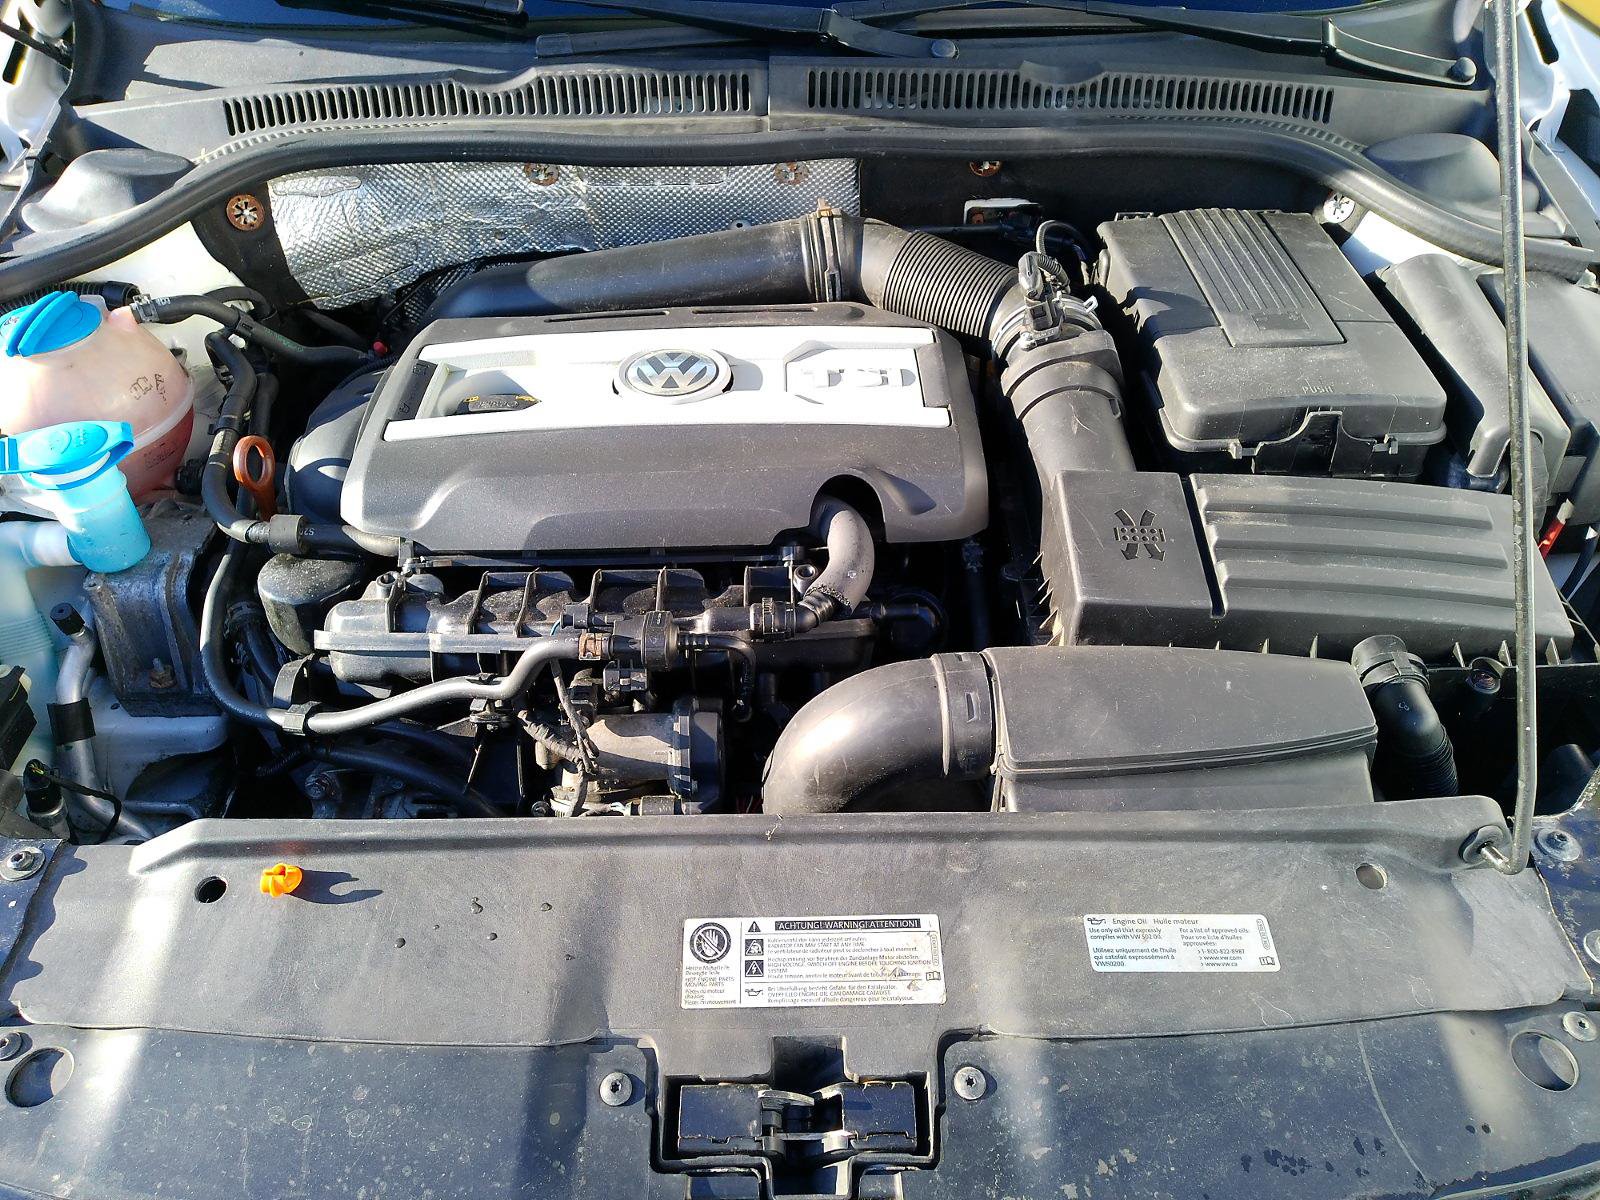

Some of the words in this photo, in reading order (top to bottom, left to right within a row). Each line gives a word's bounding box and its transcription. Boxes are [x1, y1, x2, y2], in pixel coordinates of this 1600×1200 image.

[779, 921, 822, 930] ACHTUNG!
[825, 920, 867, 929] WARNING!
[869, 919, 918, 928] ATTENTION!
[1112, 918, 1136, 926] Engine
[1211, 927, 1238, 935] approved
